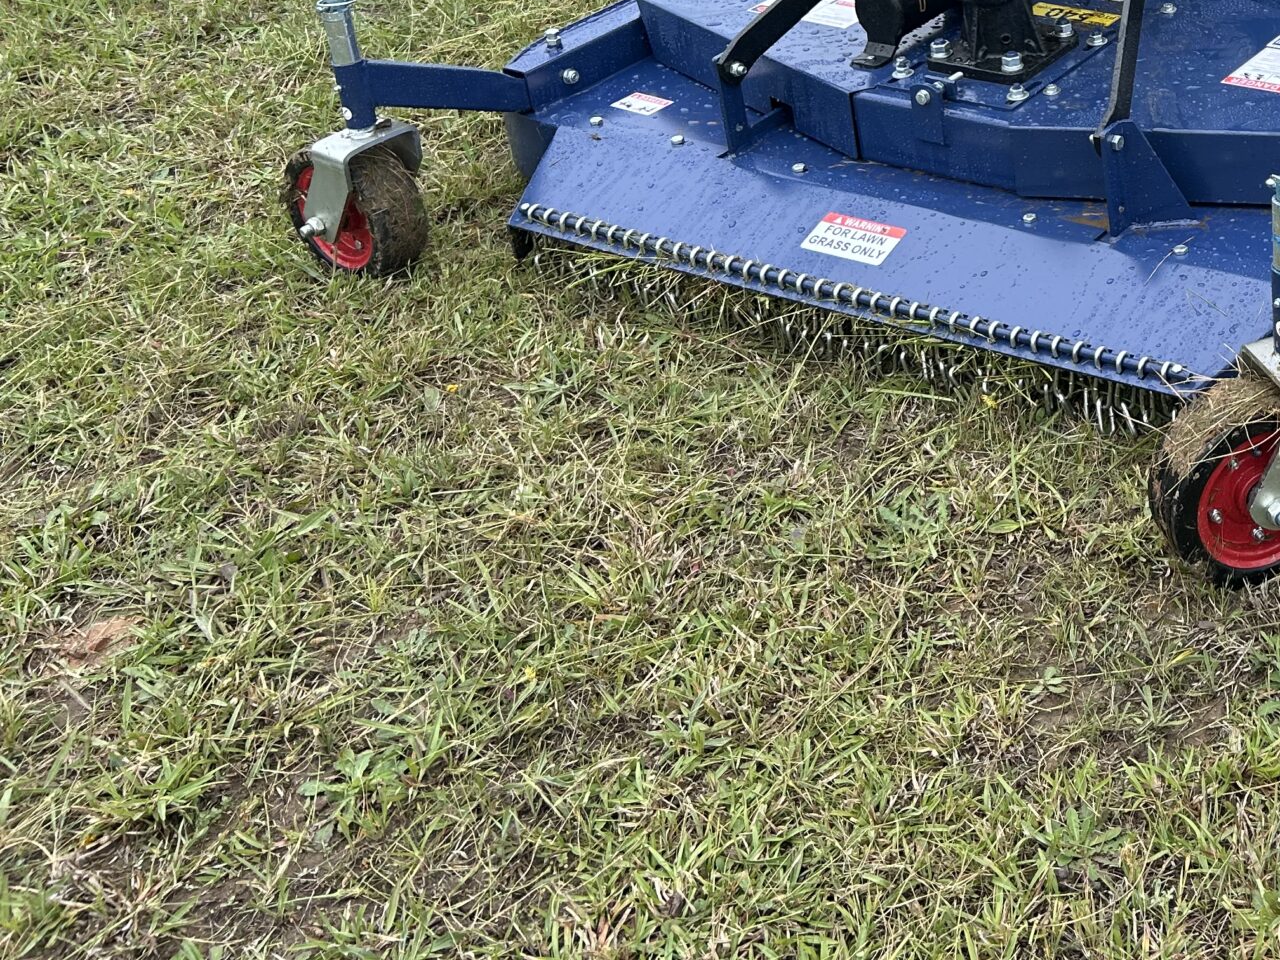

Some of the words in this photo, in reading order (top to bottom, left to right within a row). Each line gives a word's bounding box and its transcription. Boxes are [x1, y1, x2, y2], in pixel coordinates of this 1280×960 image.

[824, 224, 848, 238] FOR
[850, 230, 887, 247] LAWN
[843, 217, 891, 235] WARNING
[808, 235, 851, 252] GRASS
[851, 245, 886, 259] ONLY
